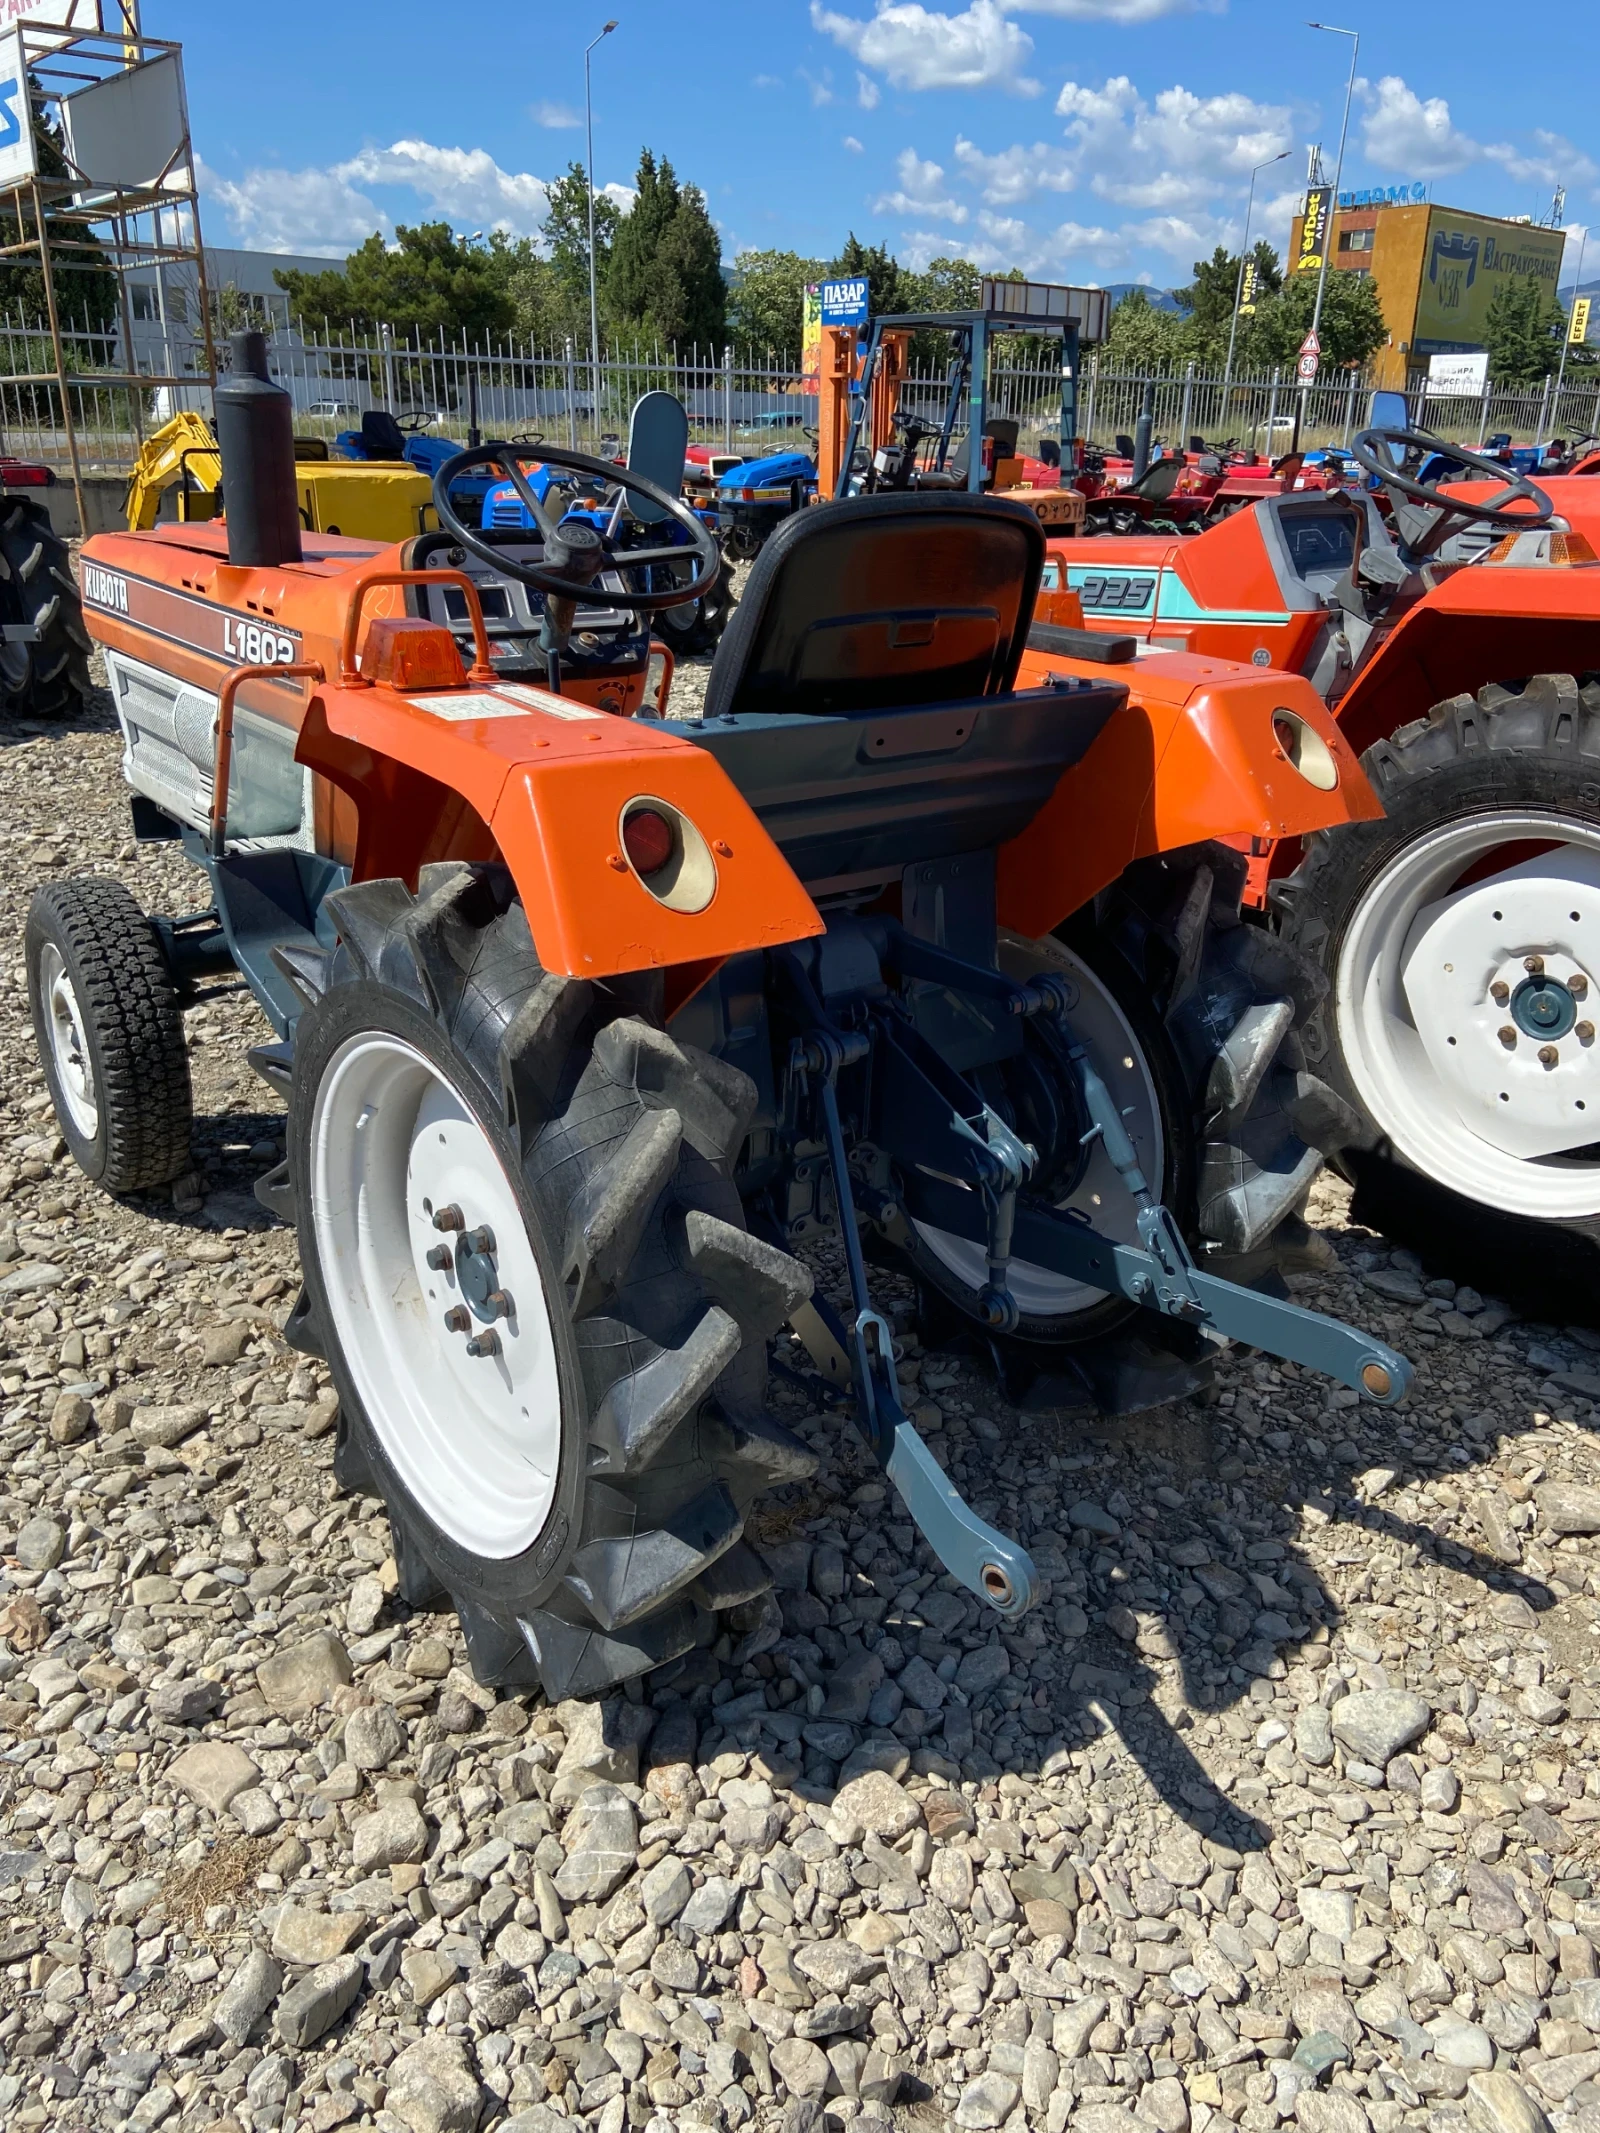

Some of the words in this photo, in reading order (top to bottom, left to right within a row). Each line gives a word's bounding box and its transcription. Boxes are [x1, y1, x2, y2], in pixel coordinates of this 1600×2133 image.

[1302, 193, 1321, 252] efbet
[824, 283, 865, 303] ПАЗАР
[1573, 303, 1586, 339] EFBET
[1303, 359, 1314, 371] 50
[1028, 502, 1083, 519] OYOTA
[85, 566, 129, 613] KUBOTA
[224, 617, 295, 664] L1802
